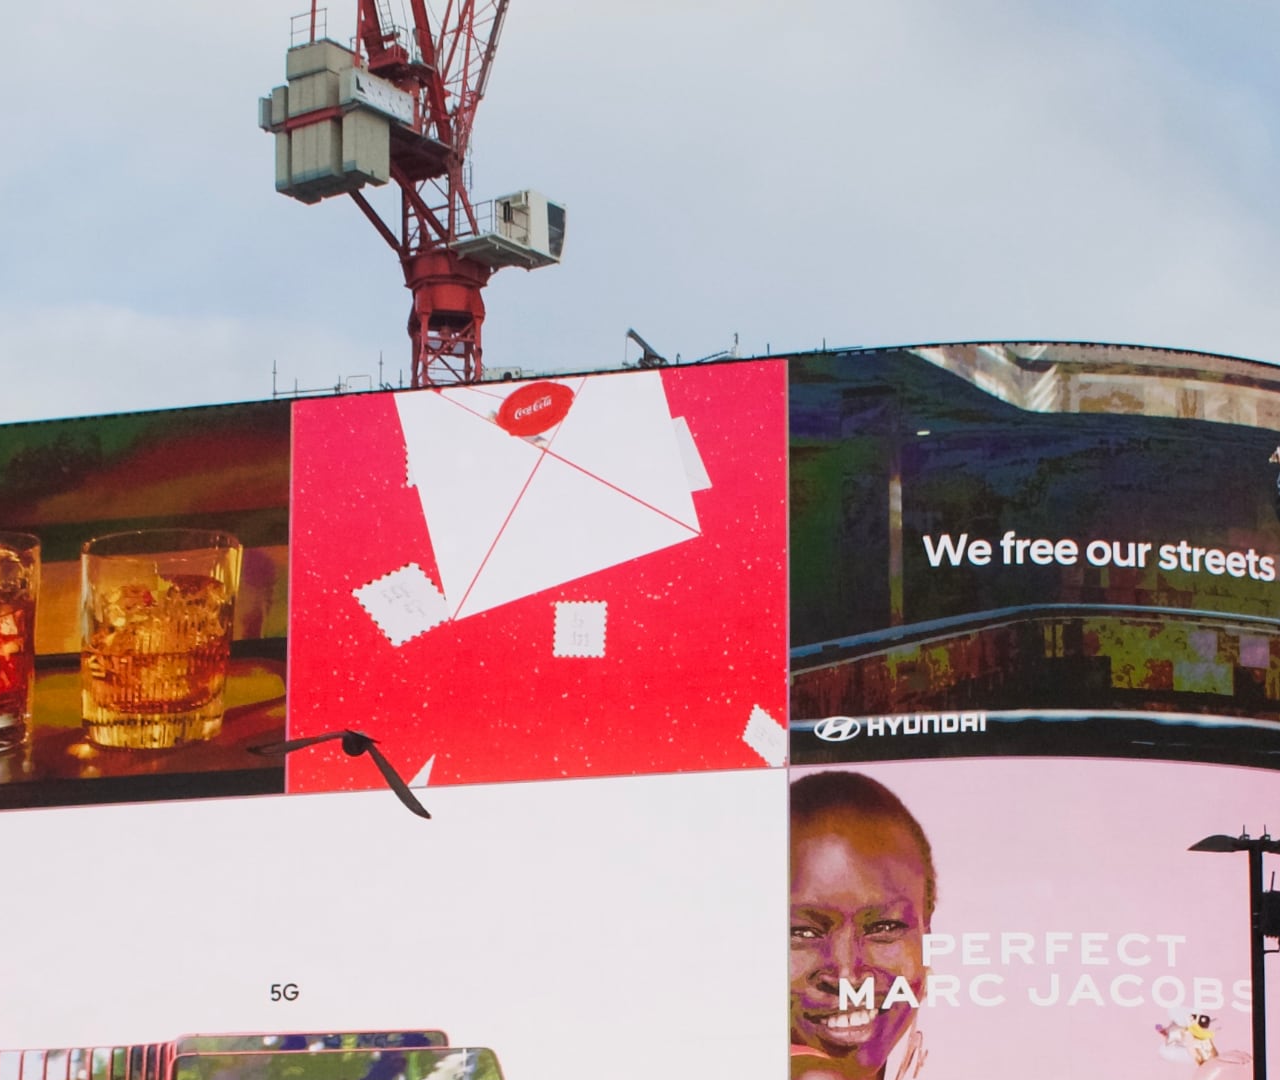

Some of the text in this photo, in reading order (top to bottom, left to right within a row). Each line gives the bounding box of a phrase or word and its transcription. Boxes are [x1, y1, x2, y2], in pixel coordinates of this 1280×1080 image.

[923, 533, 991, 568] We
[1001, 530, 1080, 566] free
[1086, 539, 1152, 569] our
[1158, 543, 1276, 582] streets
[867, 714, 986, 735] HYUNDAI
[922, 932, 1187, 967] PERFECT
[271, 983, 299, 1002] 5G
[837, 974, 1253, 1012] MARC JACOBS
